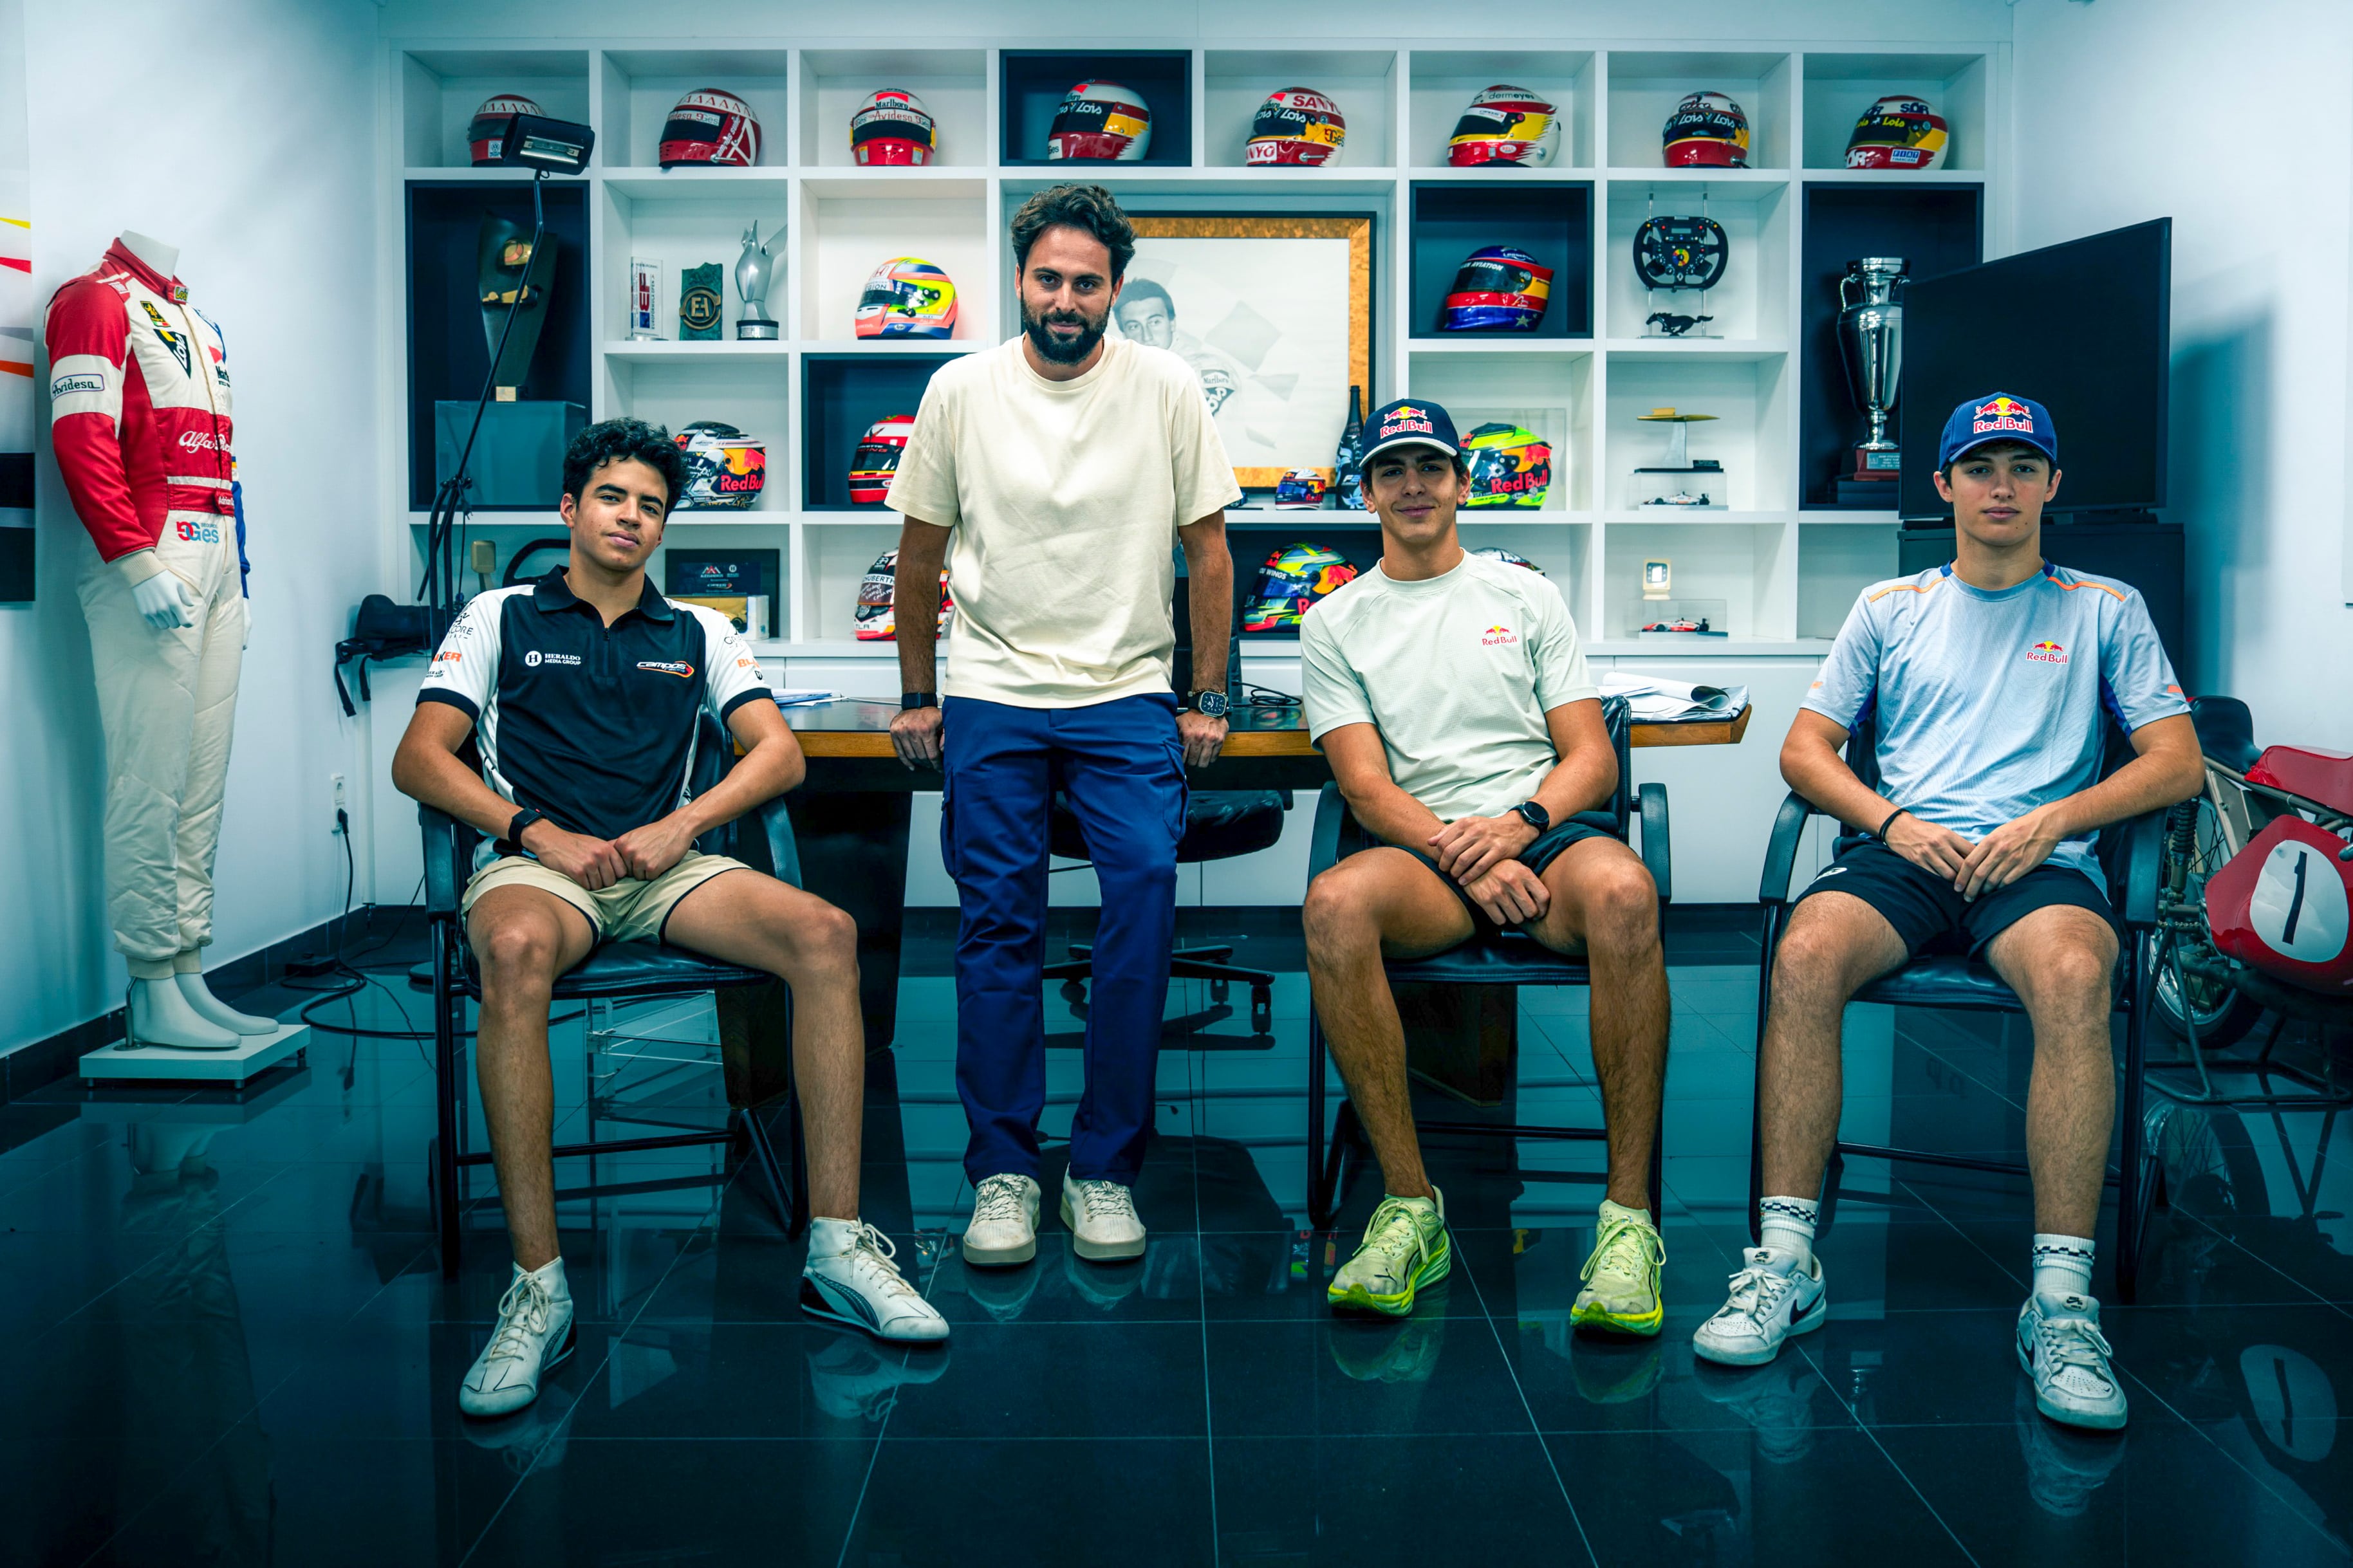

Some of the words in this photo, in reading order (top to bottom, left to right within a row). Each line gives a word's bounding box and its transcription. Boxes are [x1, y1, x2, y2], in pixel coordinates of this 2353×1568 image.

[875, 99, 908, 109] Marlboro
[1075, 102, 1102, 115] Lois
[1280, 109, 1307, 124] Lois
[1678, 114, 1704, 125] Lois
[1713, 114, 1735, 129] Lois
[1882, 116, 1905, 127] Lois
[1893, 150, 1919, 159] FIAT
[1471, 261, 1504, 272] AVIATION
[1204, 374, 1229, 384] Marlboro
[1381, 420, 1406, 438] Red
[1407, 420, 1433, 434] Bull
[1975, 417, 2004, 433] Red
[2005, 418, 2032, 432] Bull
[179, 430, 215, 454] Alfa
[720, 474, 749, 491] Red
[1491, 473, 1523, 494] Red
[1525, 469, 1548, 490] Bull
[1266, 567, 1287, 580] WINGS
[1482, 636, 1500, 646] Red
[1500, 635, 1518, 643] Bull
[2027, 652, 2047, 661] Red
[2048, 653, 2068, 663] Bull
[637, 661, 687, 670] campos
[2282, 851, 2307, 946] 1
